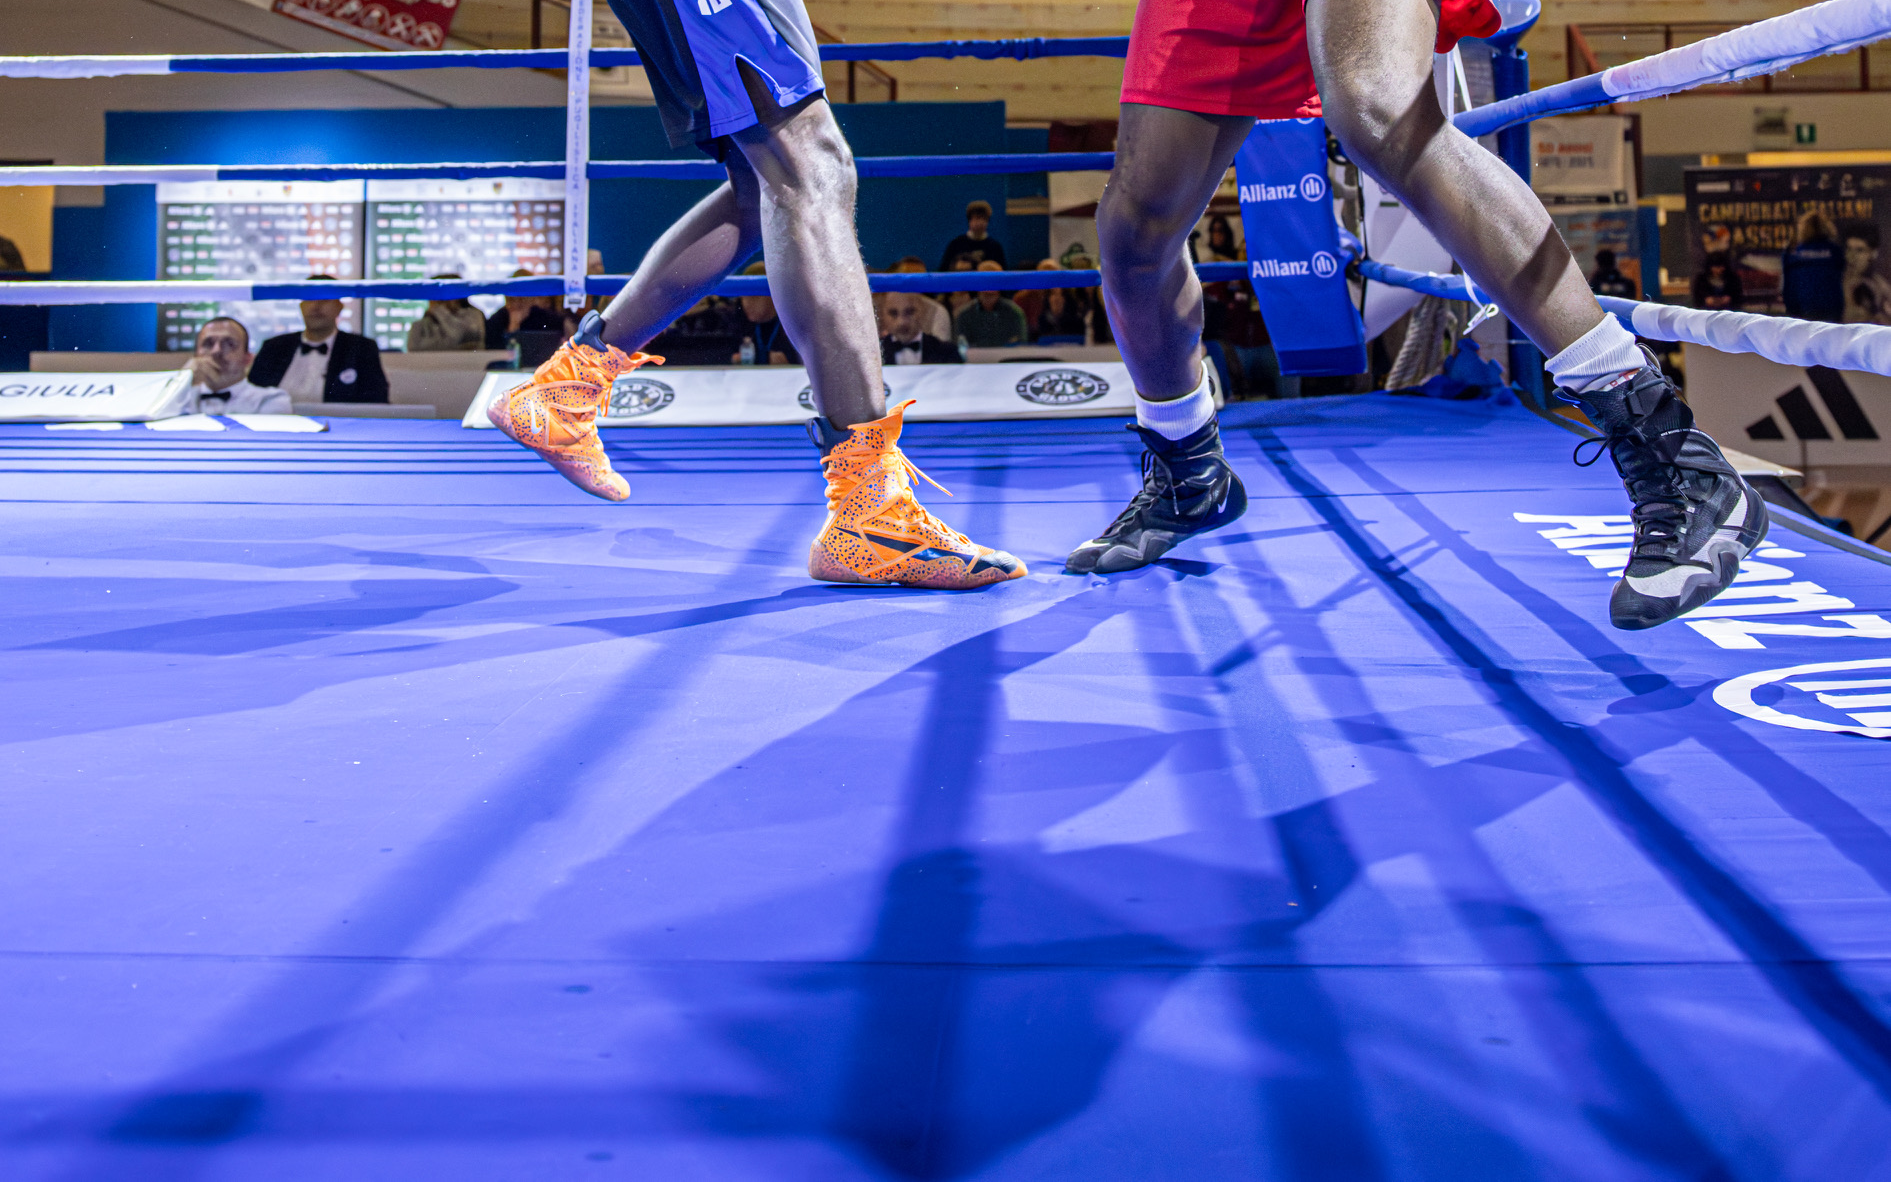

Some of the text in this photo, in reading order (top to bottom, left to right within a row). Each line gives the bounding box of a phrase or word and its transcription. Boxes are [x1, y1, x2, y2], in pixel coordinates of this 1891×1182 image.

[1239, 183, 1298, 204] Allianz
[1252, 258, 1311, 279] Allianz
[0, 384, 116, 398] GIULIA
